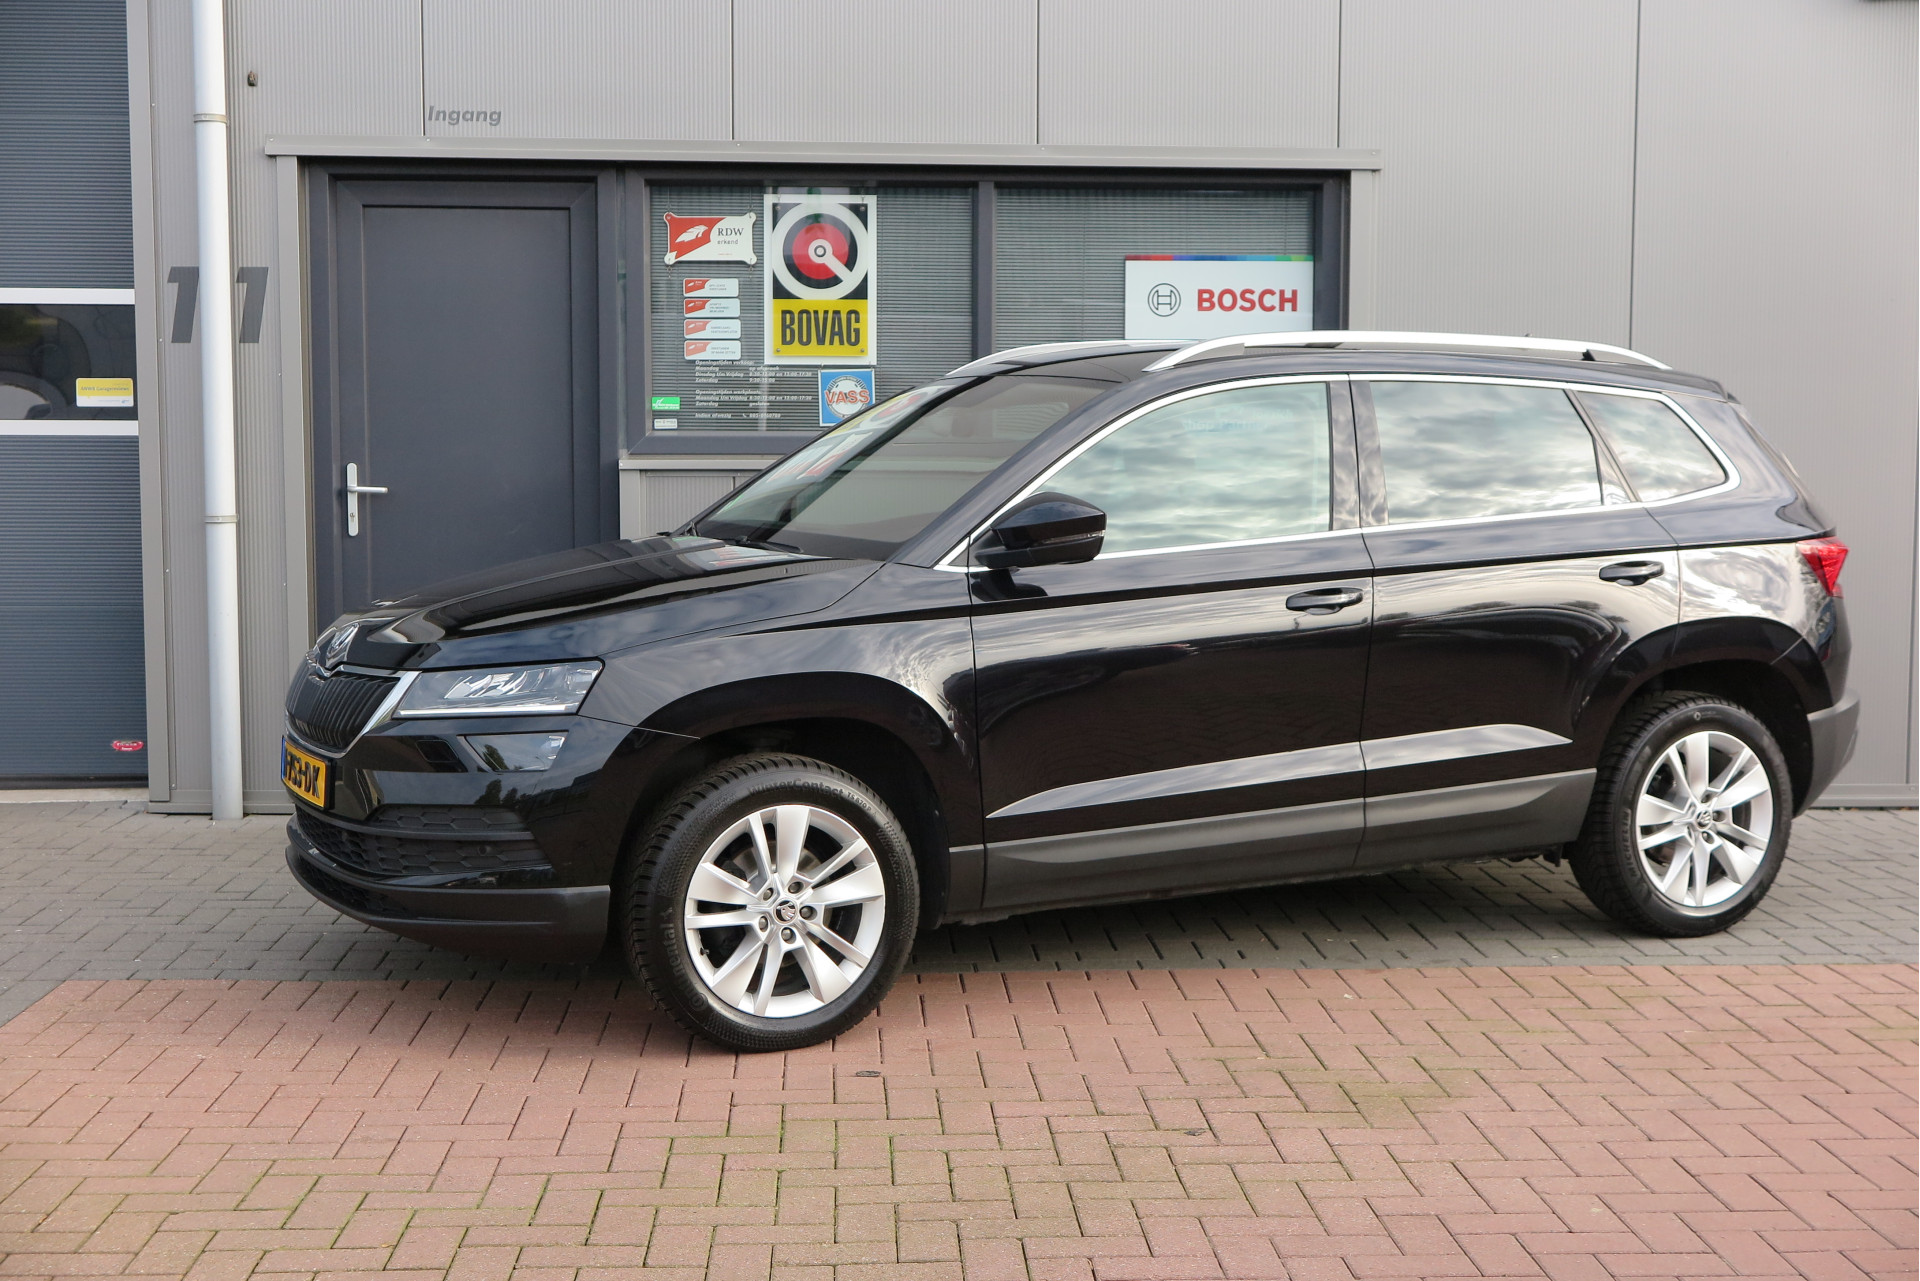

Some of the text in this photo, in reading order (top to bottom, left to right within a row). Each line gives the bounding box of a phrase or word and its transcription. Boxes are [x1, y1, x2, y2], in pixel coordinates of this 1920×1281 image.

[427, 104, 502, 127] Ingang
[717, 227, 745, 237] RDW
[1197, 288, 1298, 312] BOSCH
[780, 308, 861, 347] BOVAG
[824, 389, 870, 405] VASS
